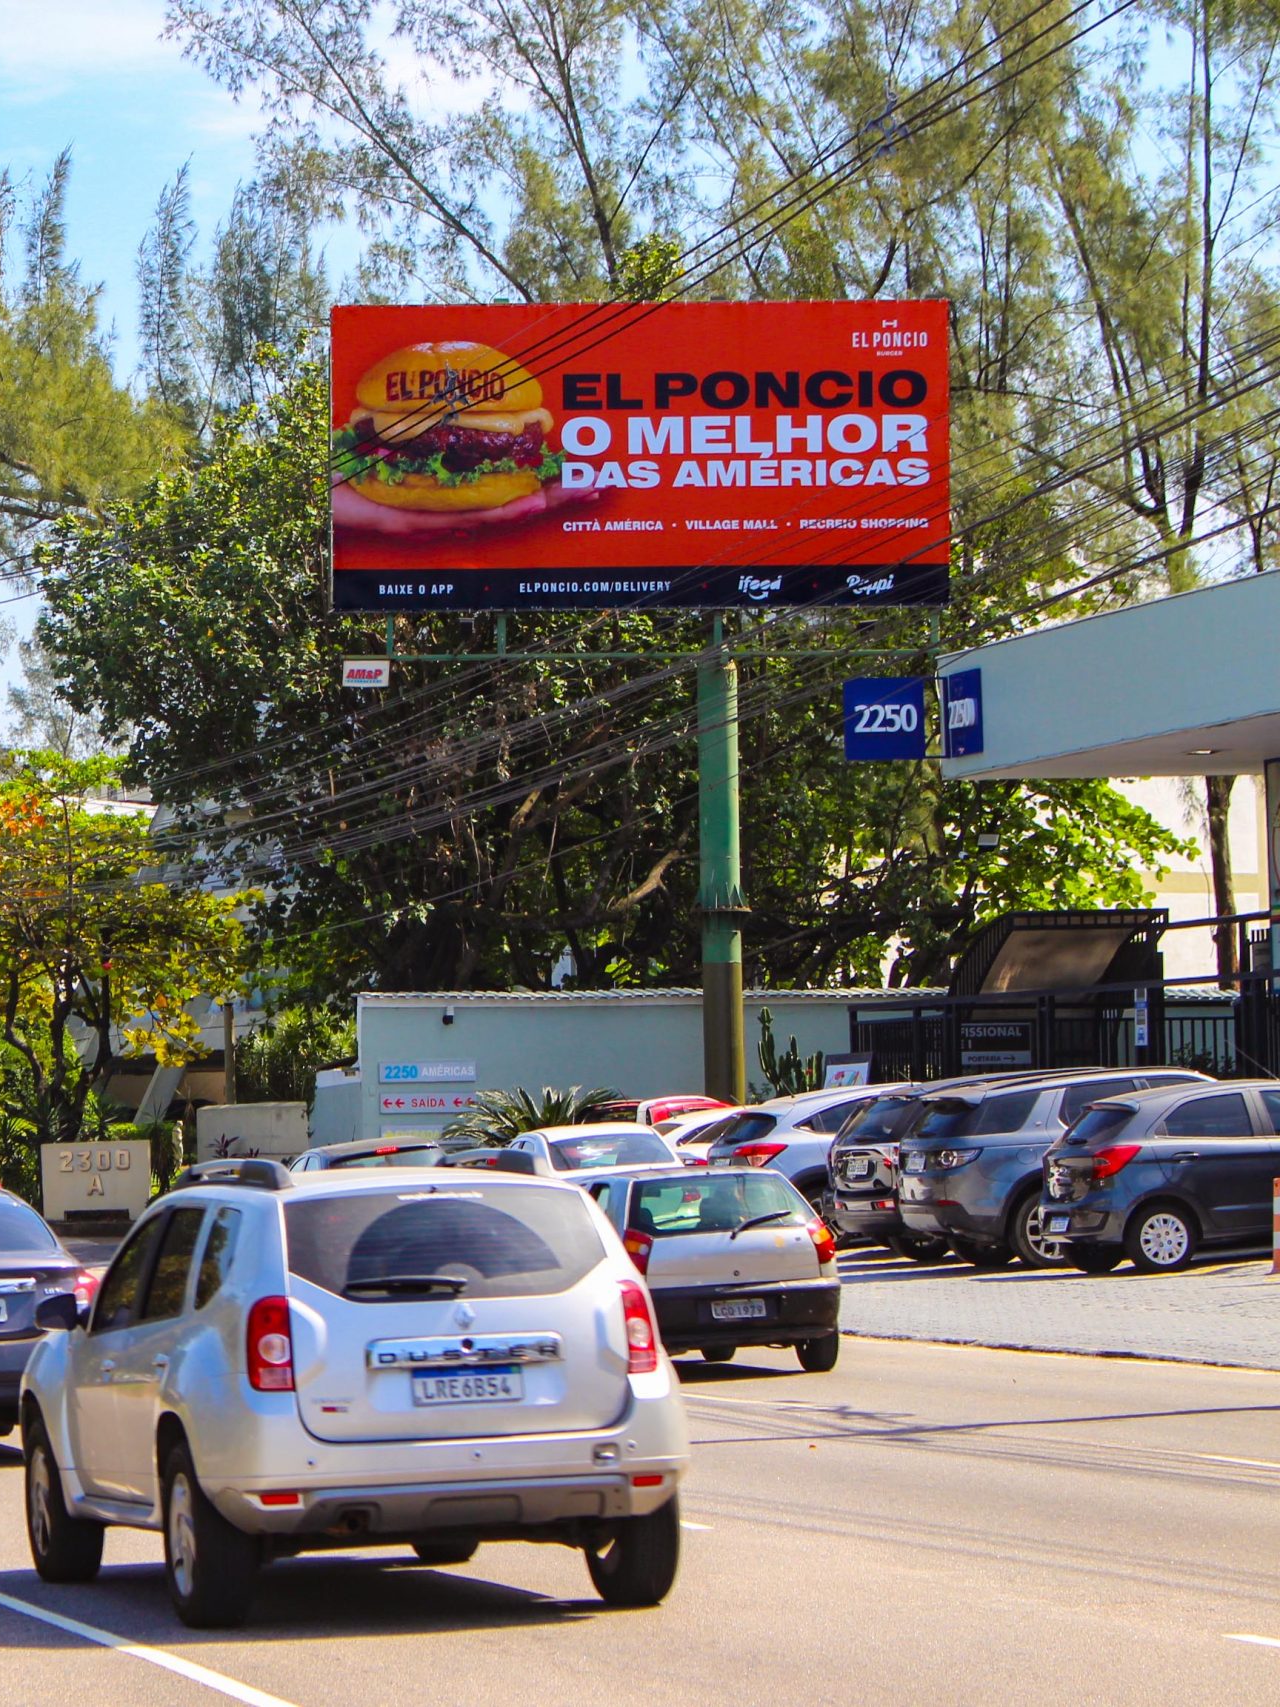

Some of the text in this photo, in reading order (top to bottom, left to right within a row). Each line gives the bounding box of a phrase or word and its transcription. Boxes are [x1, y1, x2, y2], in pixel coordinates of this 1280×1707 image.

[852, 331, 928, 348] EL PONCIO
[385, 369, 506, 402] EL PONCIO
[563, 370, 927, 410] EL PONCIO
[561, 413, 928, 456] O MELHOR
[562, 451, 930, 489] DAS AMÉRICAS
[563, 518, 663, 531] CITTÀ AMÉRICA
[686, 519, 778, 530] VILLAGE MALL
[799, 518, 929, 529] RECREIO SHOPPING
[379, 584, 454, 595] BAIXE O APP
[519, 581, 671, 593] ELPONCIO.COM/DELIVERY
[346, 668, 383, 680] AM&P
[854, 703, 918, 733] 2250
[384, 1063, 474, 1079] 2250 AMÉRICAS
[411, 1097, 446, 1108] SAÍDA
[59, 1149, 131, 1172] 2300
[87, 1174, 104, 1196] A
[378, 1343, 560, 1364] DUSTER
[422, 1376, 511, 1401] LRE6B54
